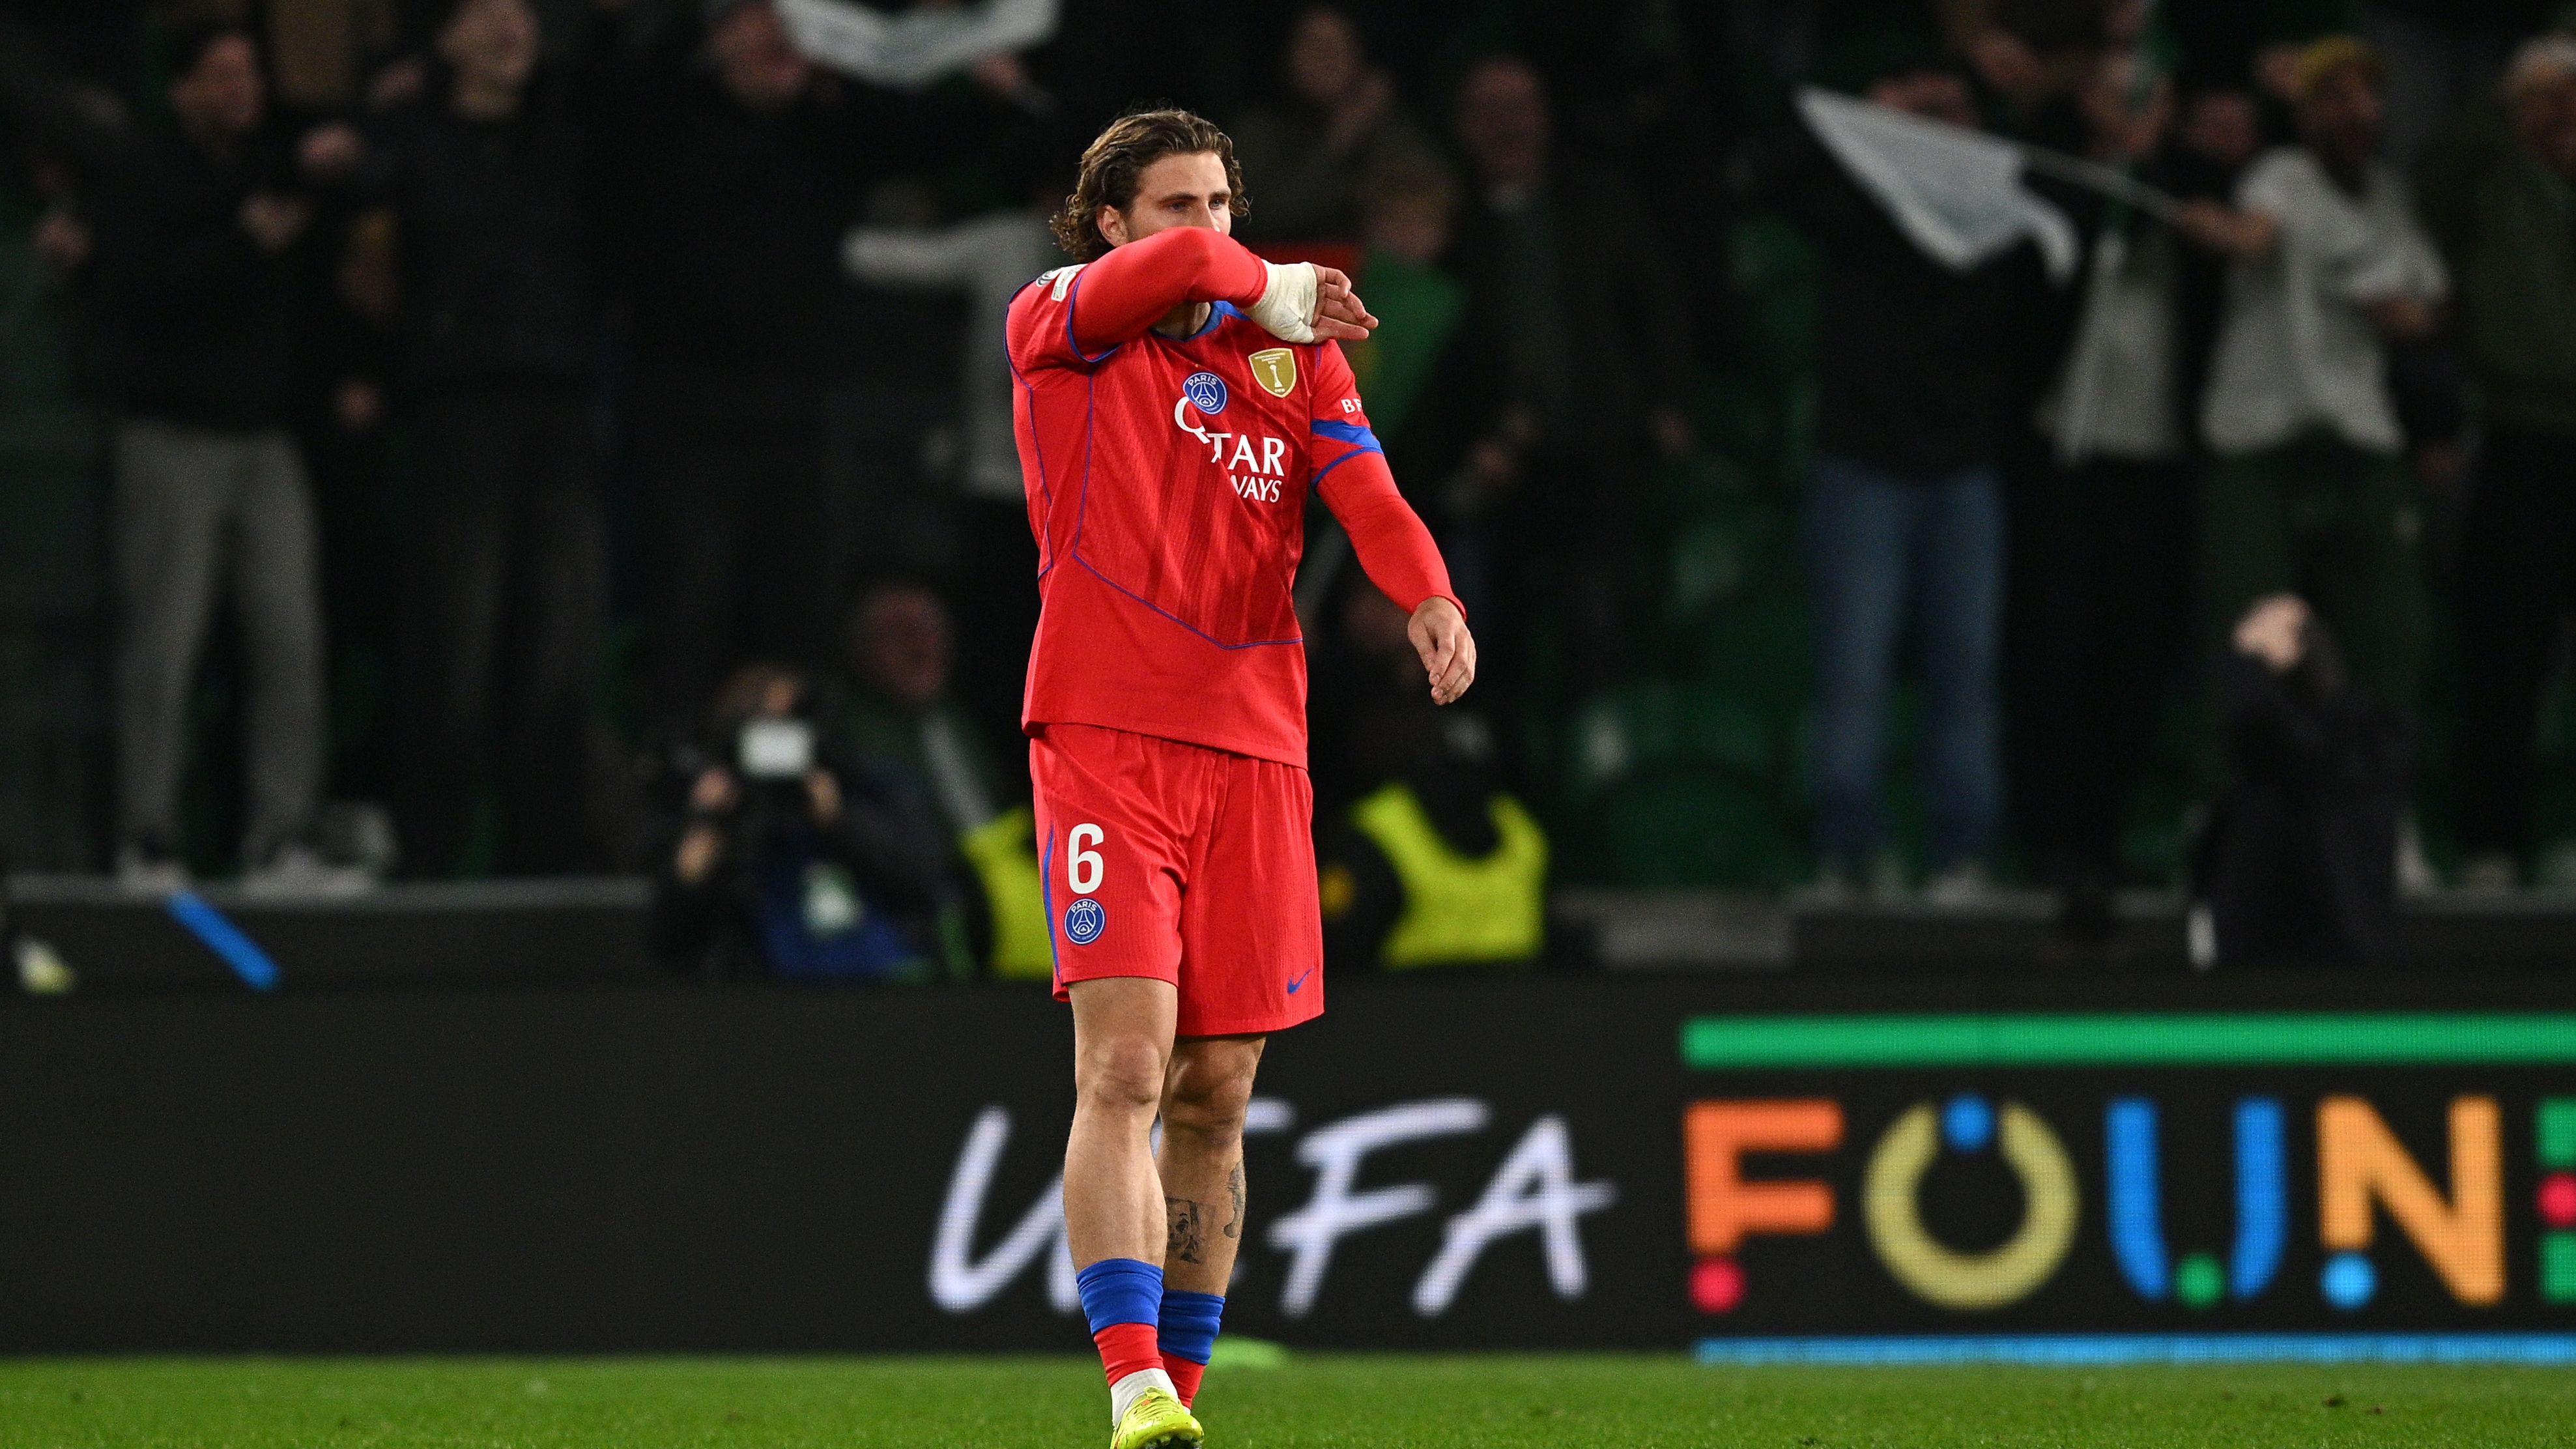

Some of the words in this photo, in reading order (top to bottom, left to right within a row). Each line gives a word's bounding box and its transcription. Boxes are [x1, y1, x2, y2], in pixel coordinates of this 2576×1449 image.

[1188, 375, 1217, 386] PARIS
[1174, 395, 1285, 476] QTAR
[1068, 823, 1104, 894] 6
[1070, 900, 1097, 913] PARIS
[928, 1097, 1616, 1312] UFA
[1683, 1095, 2576, 1311] FOUN
